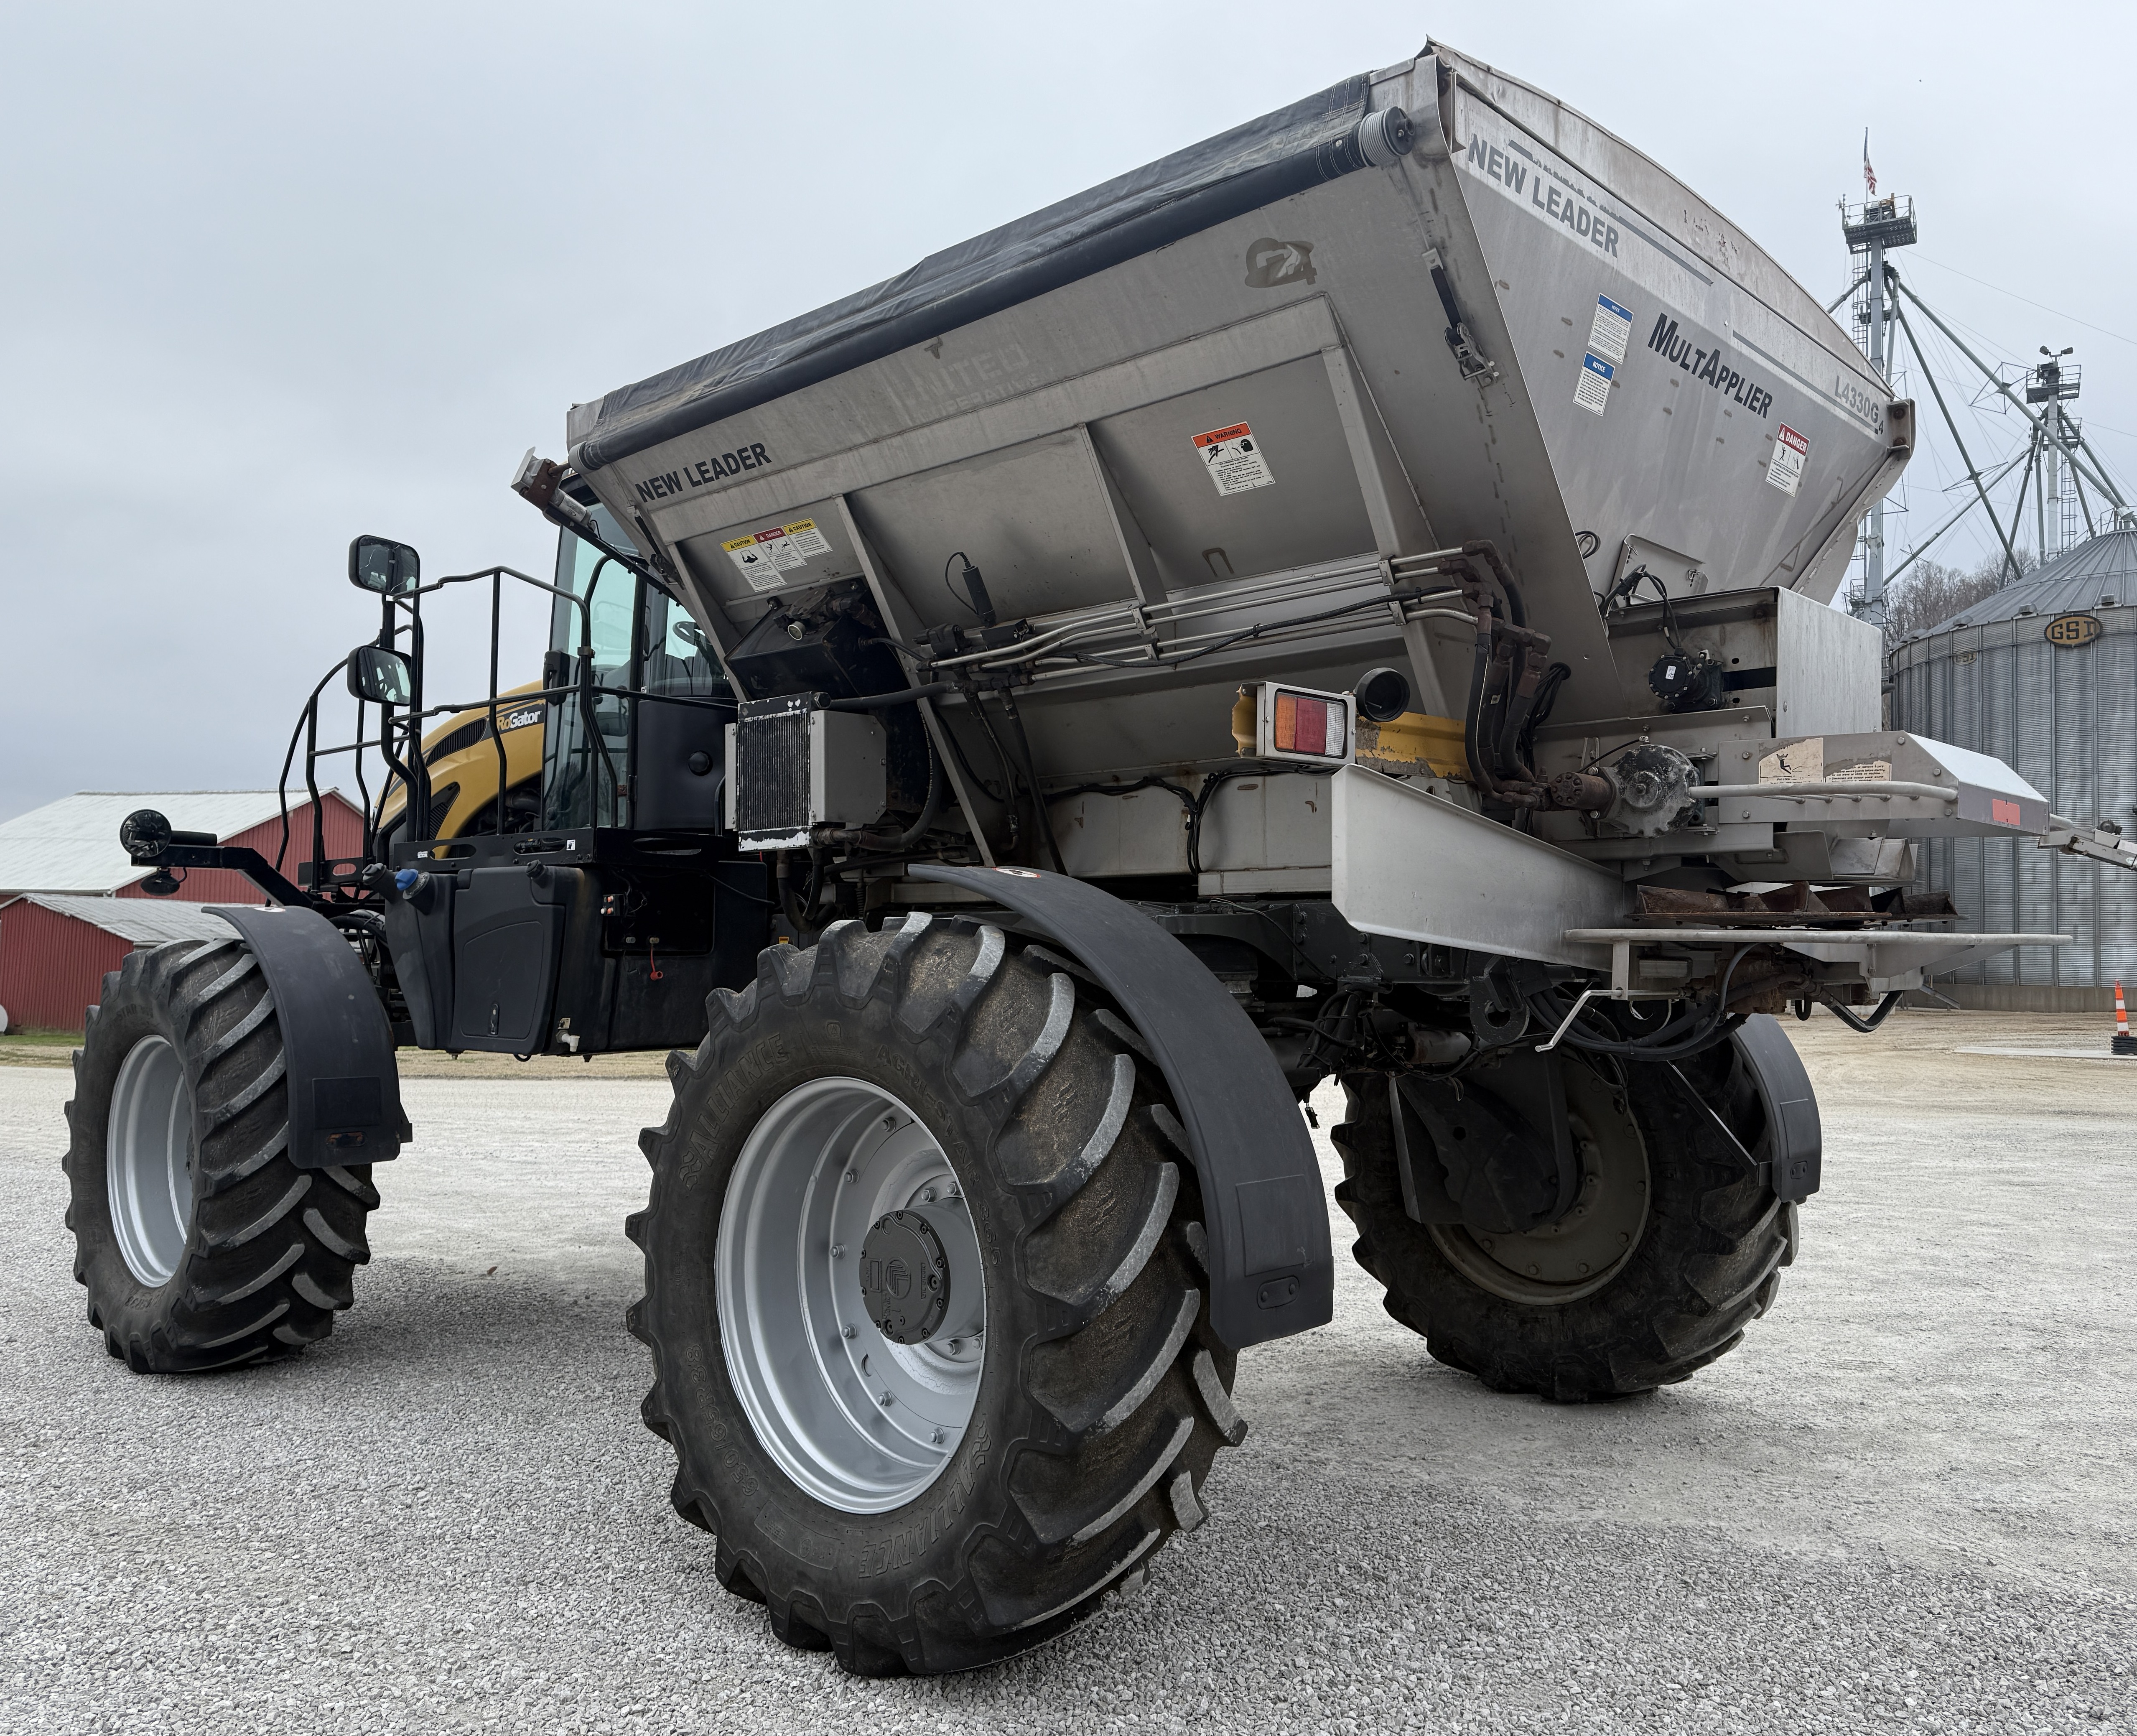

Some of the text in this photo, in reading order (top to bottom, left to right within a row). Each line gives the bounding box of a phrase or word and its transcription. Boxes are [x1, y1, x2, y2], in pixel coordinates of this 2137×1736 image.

[1468, 133, 1619, 258] NEW LEADER
[1592, 360, 1606, 373] NOTICE
[1215, 428, 1242, 439] WARNING
[1786, 431, 1807, 453] DANGER
[635, 442, 772, 503] NEW LEADER
[765, 530, 782, 539] DANGER
[793, 522, 812, 531] CAUTION
[734, 538, 751, 547] CAUTION
[2051, 620, 2095, 640] GSI
[497, 711, 540, 731] RoGator
[689, 1033, 789, 1167] ALLIANCE
[978, 1198, 1003, 1264] 365
[858, 1442, 975, 1579] ALLIANCE
